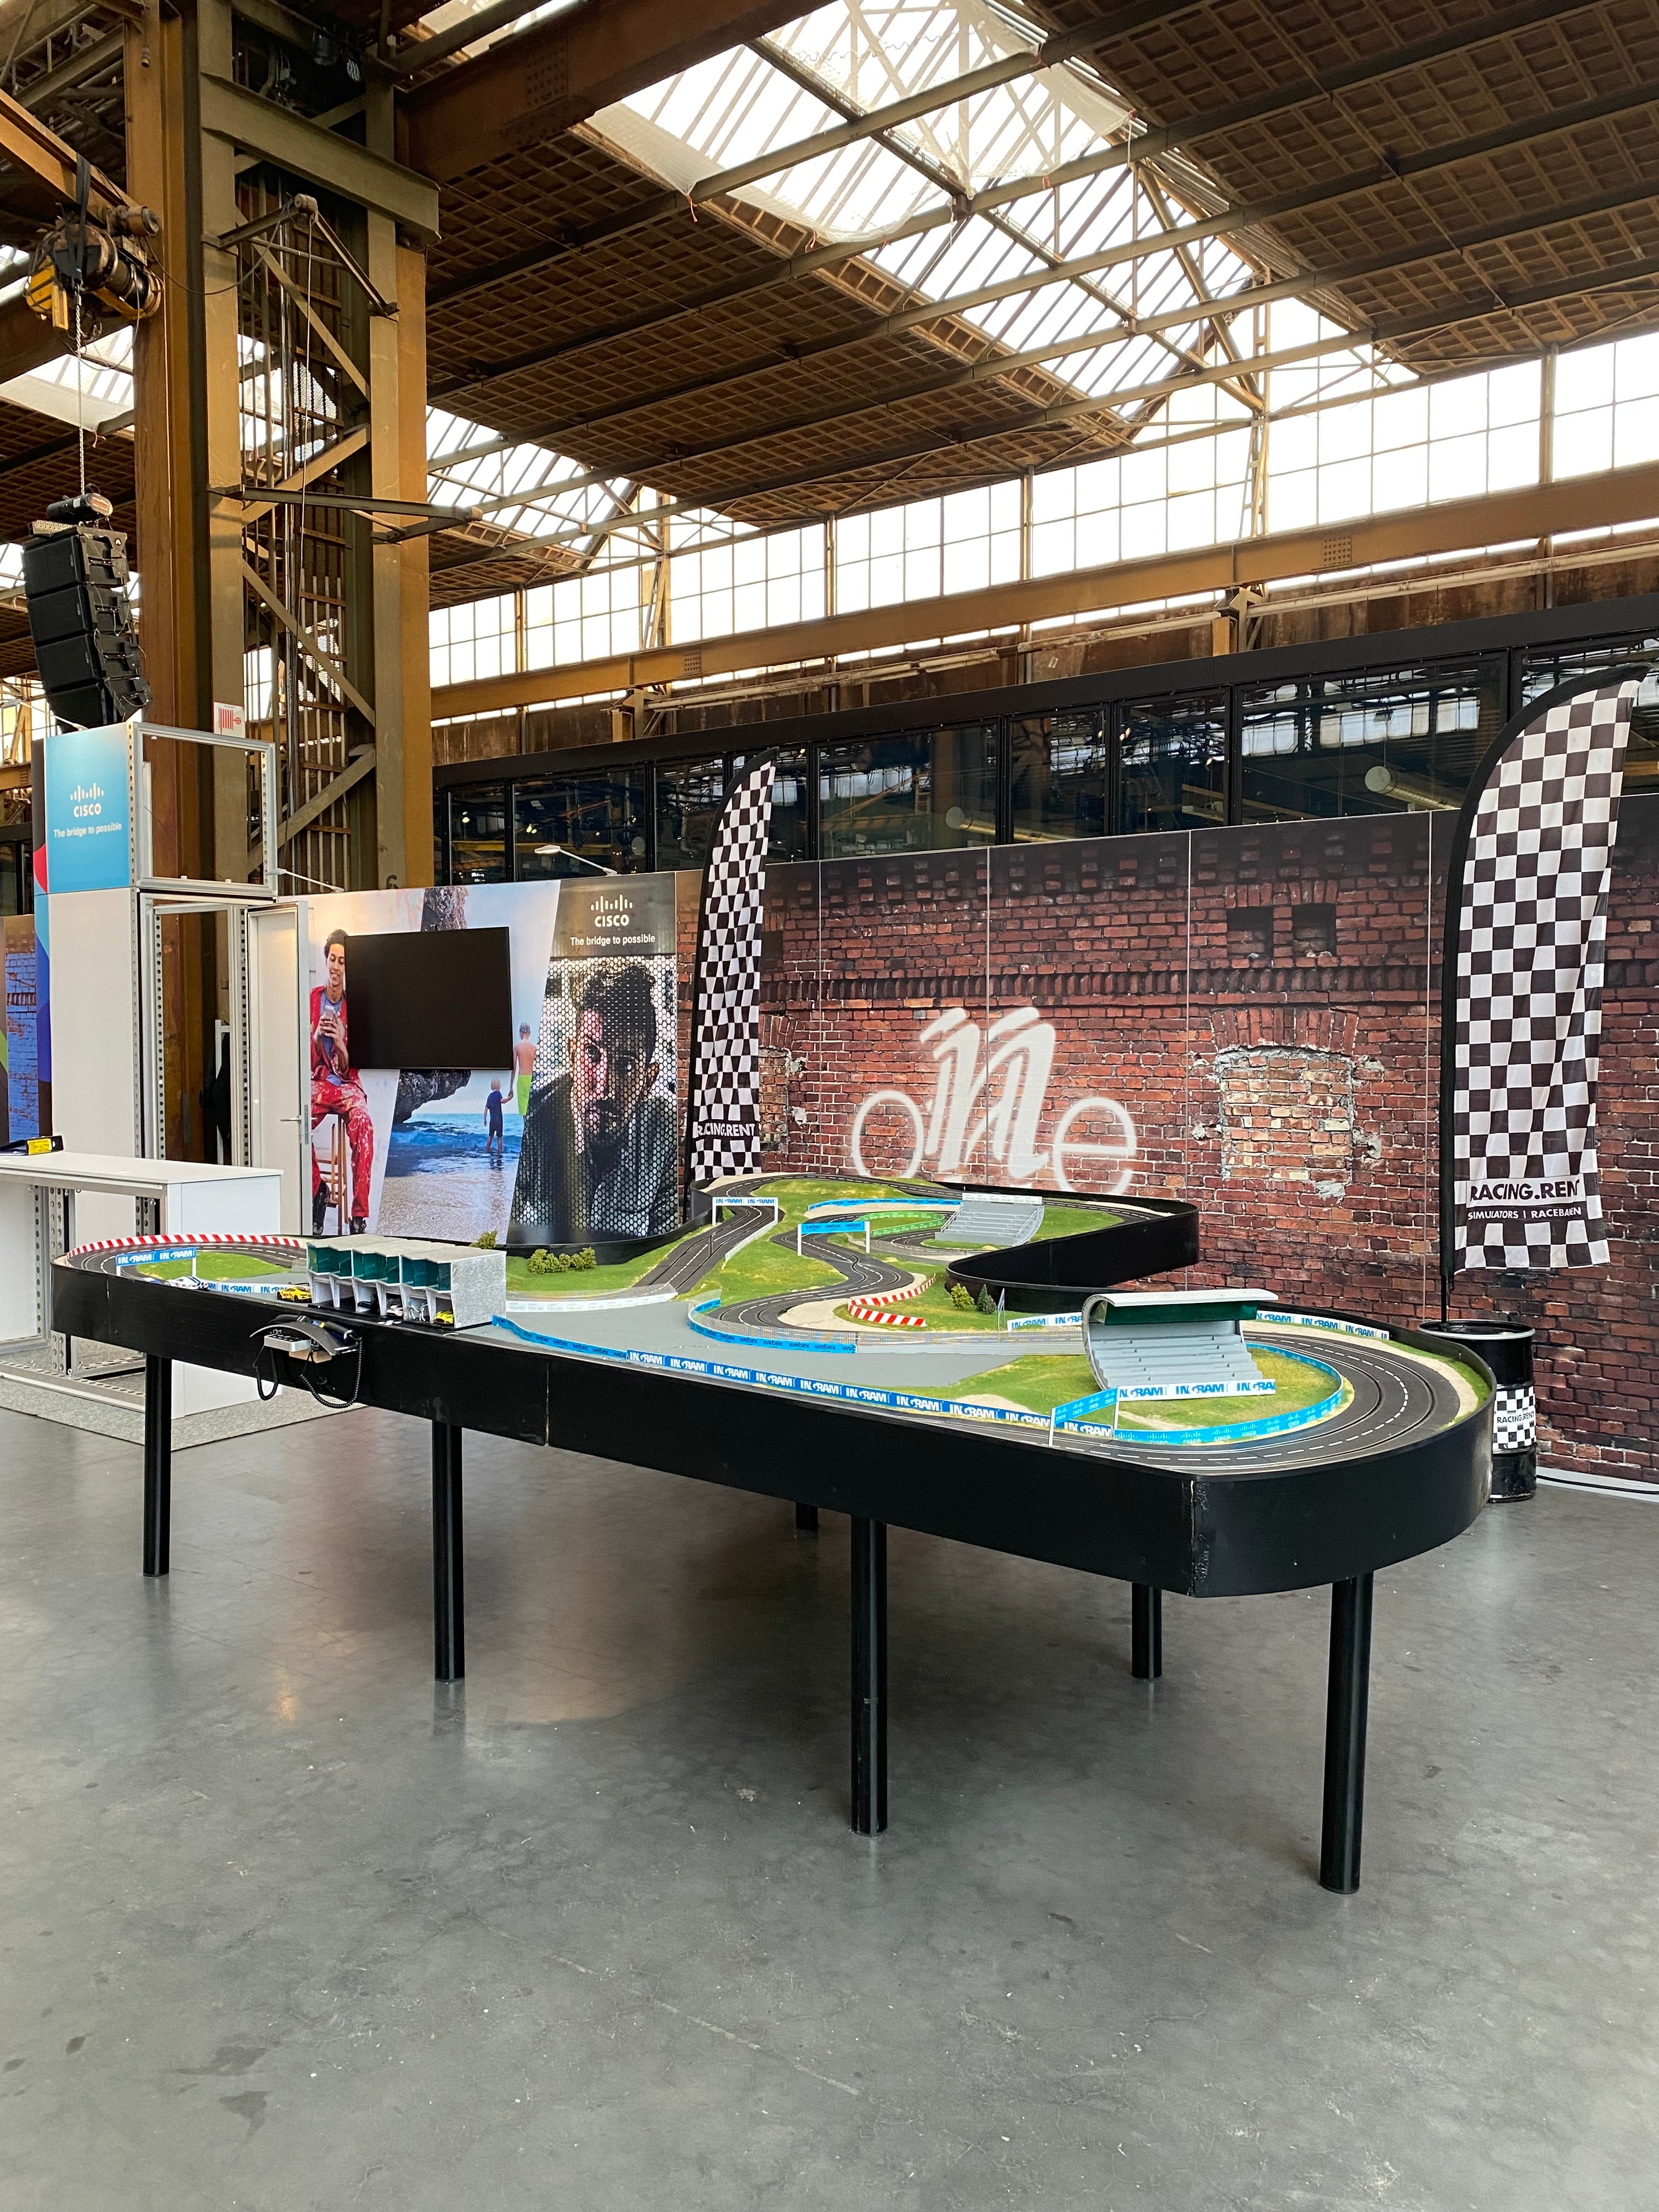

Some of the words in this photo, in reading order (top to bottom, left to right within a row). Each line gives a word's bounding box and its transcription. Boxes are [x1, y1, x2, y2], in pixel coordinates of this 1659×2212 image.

[74, 803, 101, 817] CISCO
[53, 829, 65, 838] The
[67, 827, 87, 837] bridge
[88, 826, 94, 834] to
[96, 822, 122, 834] possible
[594, 914, 629, 928] CISCO
[570, 937, 584, 946] The
[586, 936, 611, 947] bridge
[613, 936, 620, 944] to
[623, 934, 656, 945] possible
[1468, 1209, 1519, 1220] SIMULATORS
[1055, 1316, 1082, 1324] INGRA
[553, 1339, 568, 1347] webex
[592, 1347, 608, 1355] webex
[613, 1351, 627, 1359] webe
[1119, 1386, 1163, 1398] NGRAM
